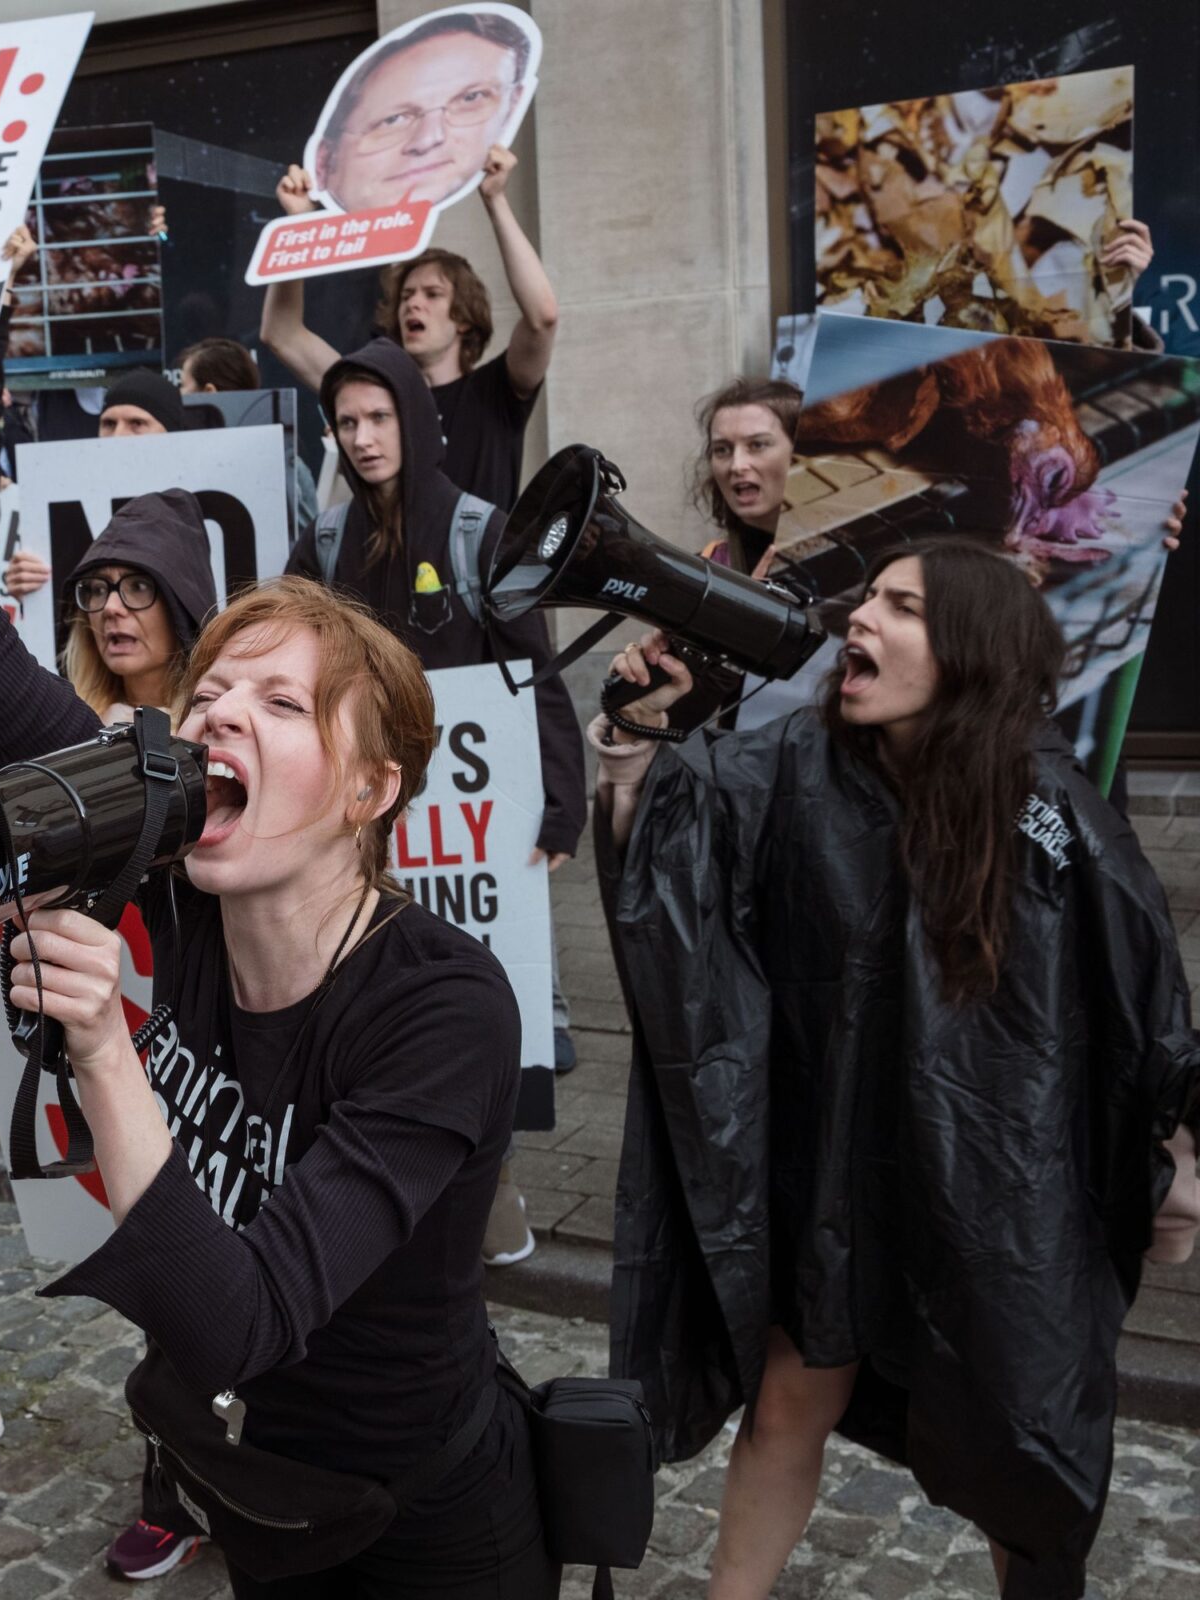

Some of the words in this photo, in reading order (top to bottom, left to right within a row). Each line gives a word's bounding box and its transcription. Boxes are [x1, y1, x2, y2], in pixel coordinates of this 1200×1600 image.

[267, 247, 309, 269] First
[312, 245, 332, 260] to
[334, 237, 367, 257] fail
[275, 226, 315, 248] First
[320, 223, 336, 239] in
[340, 218, 371, 236] the
[373, 210, 414, 231] role.
[414, 721, 490, 797] 'S
[395, 800, 494, 869] LLY
[1013, 808, 1073, 872] QUALITY
[1026, 793, 1076, 848] animal
[404, 872, 499, 926] ING
